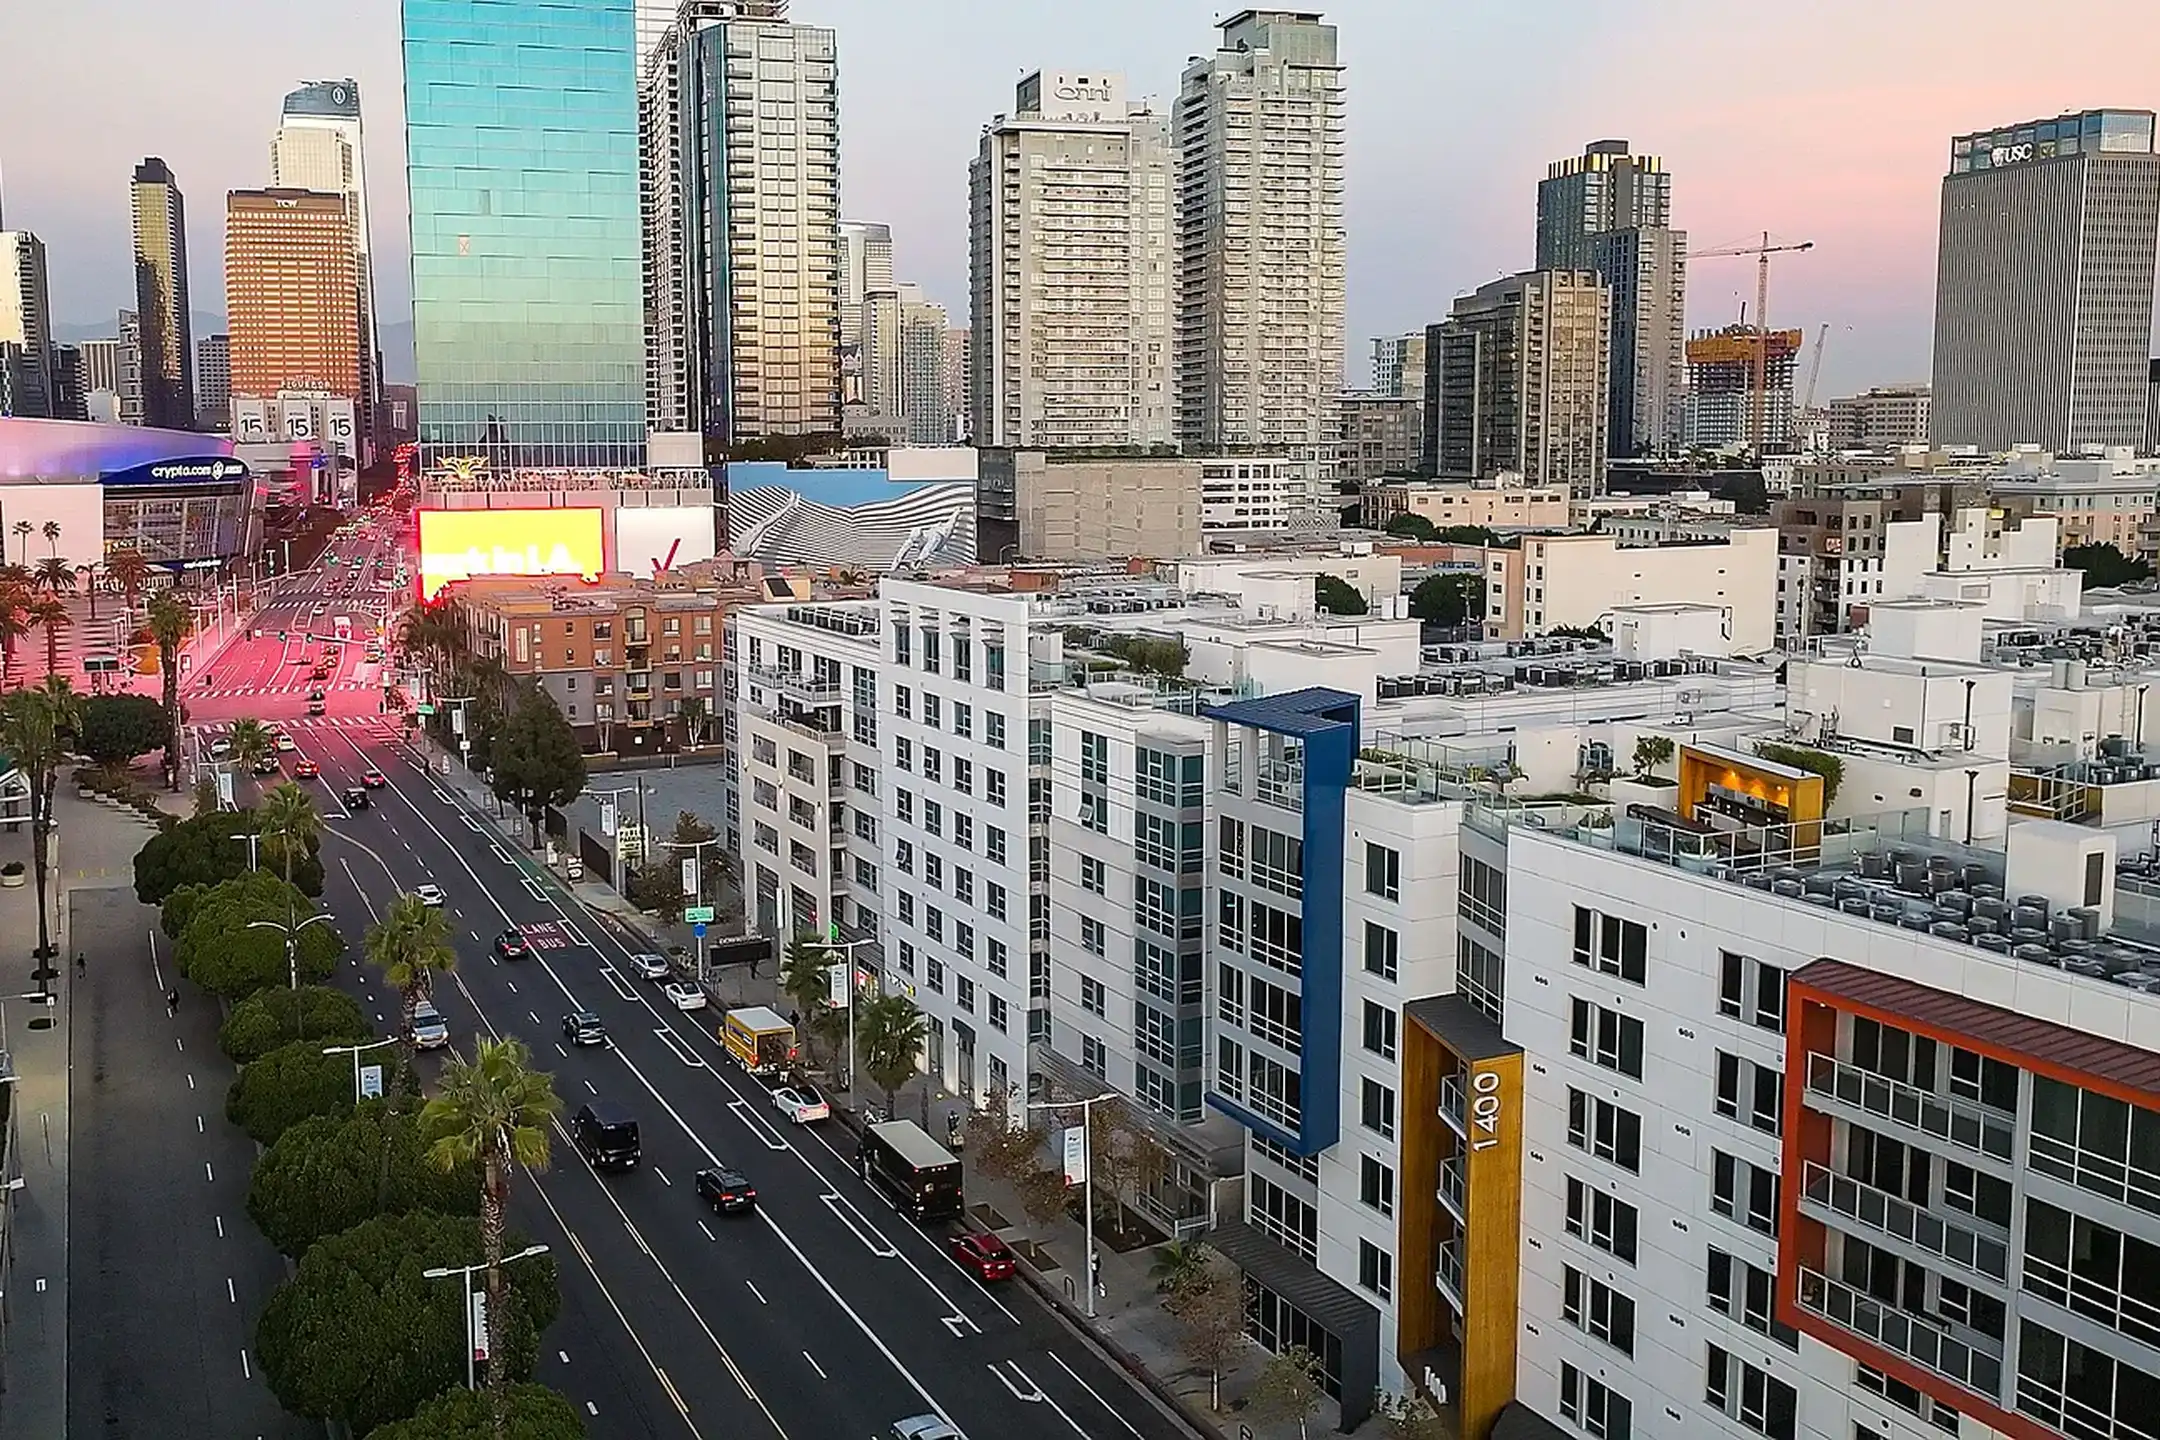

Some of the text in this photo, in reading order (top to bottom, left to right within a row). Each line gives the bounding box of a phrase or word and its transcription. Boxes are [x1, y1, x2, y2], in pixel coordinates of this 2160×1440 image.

[2004, 143, 2033, 163] USC
[275, 199, 299, 208] TCW
[240, 418, 264, 434] 15
[286, 418, 310, 438] 15
[329, 418, 353, 438] 15
[151, 464, 212, 479] crypto.com
[520, 922, 557, 934] LANE
[536, 937, 567, 950] BUS
[1472, 1071, 1500, 1152] 1400
